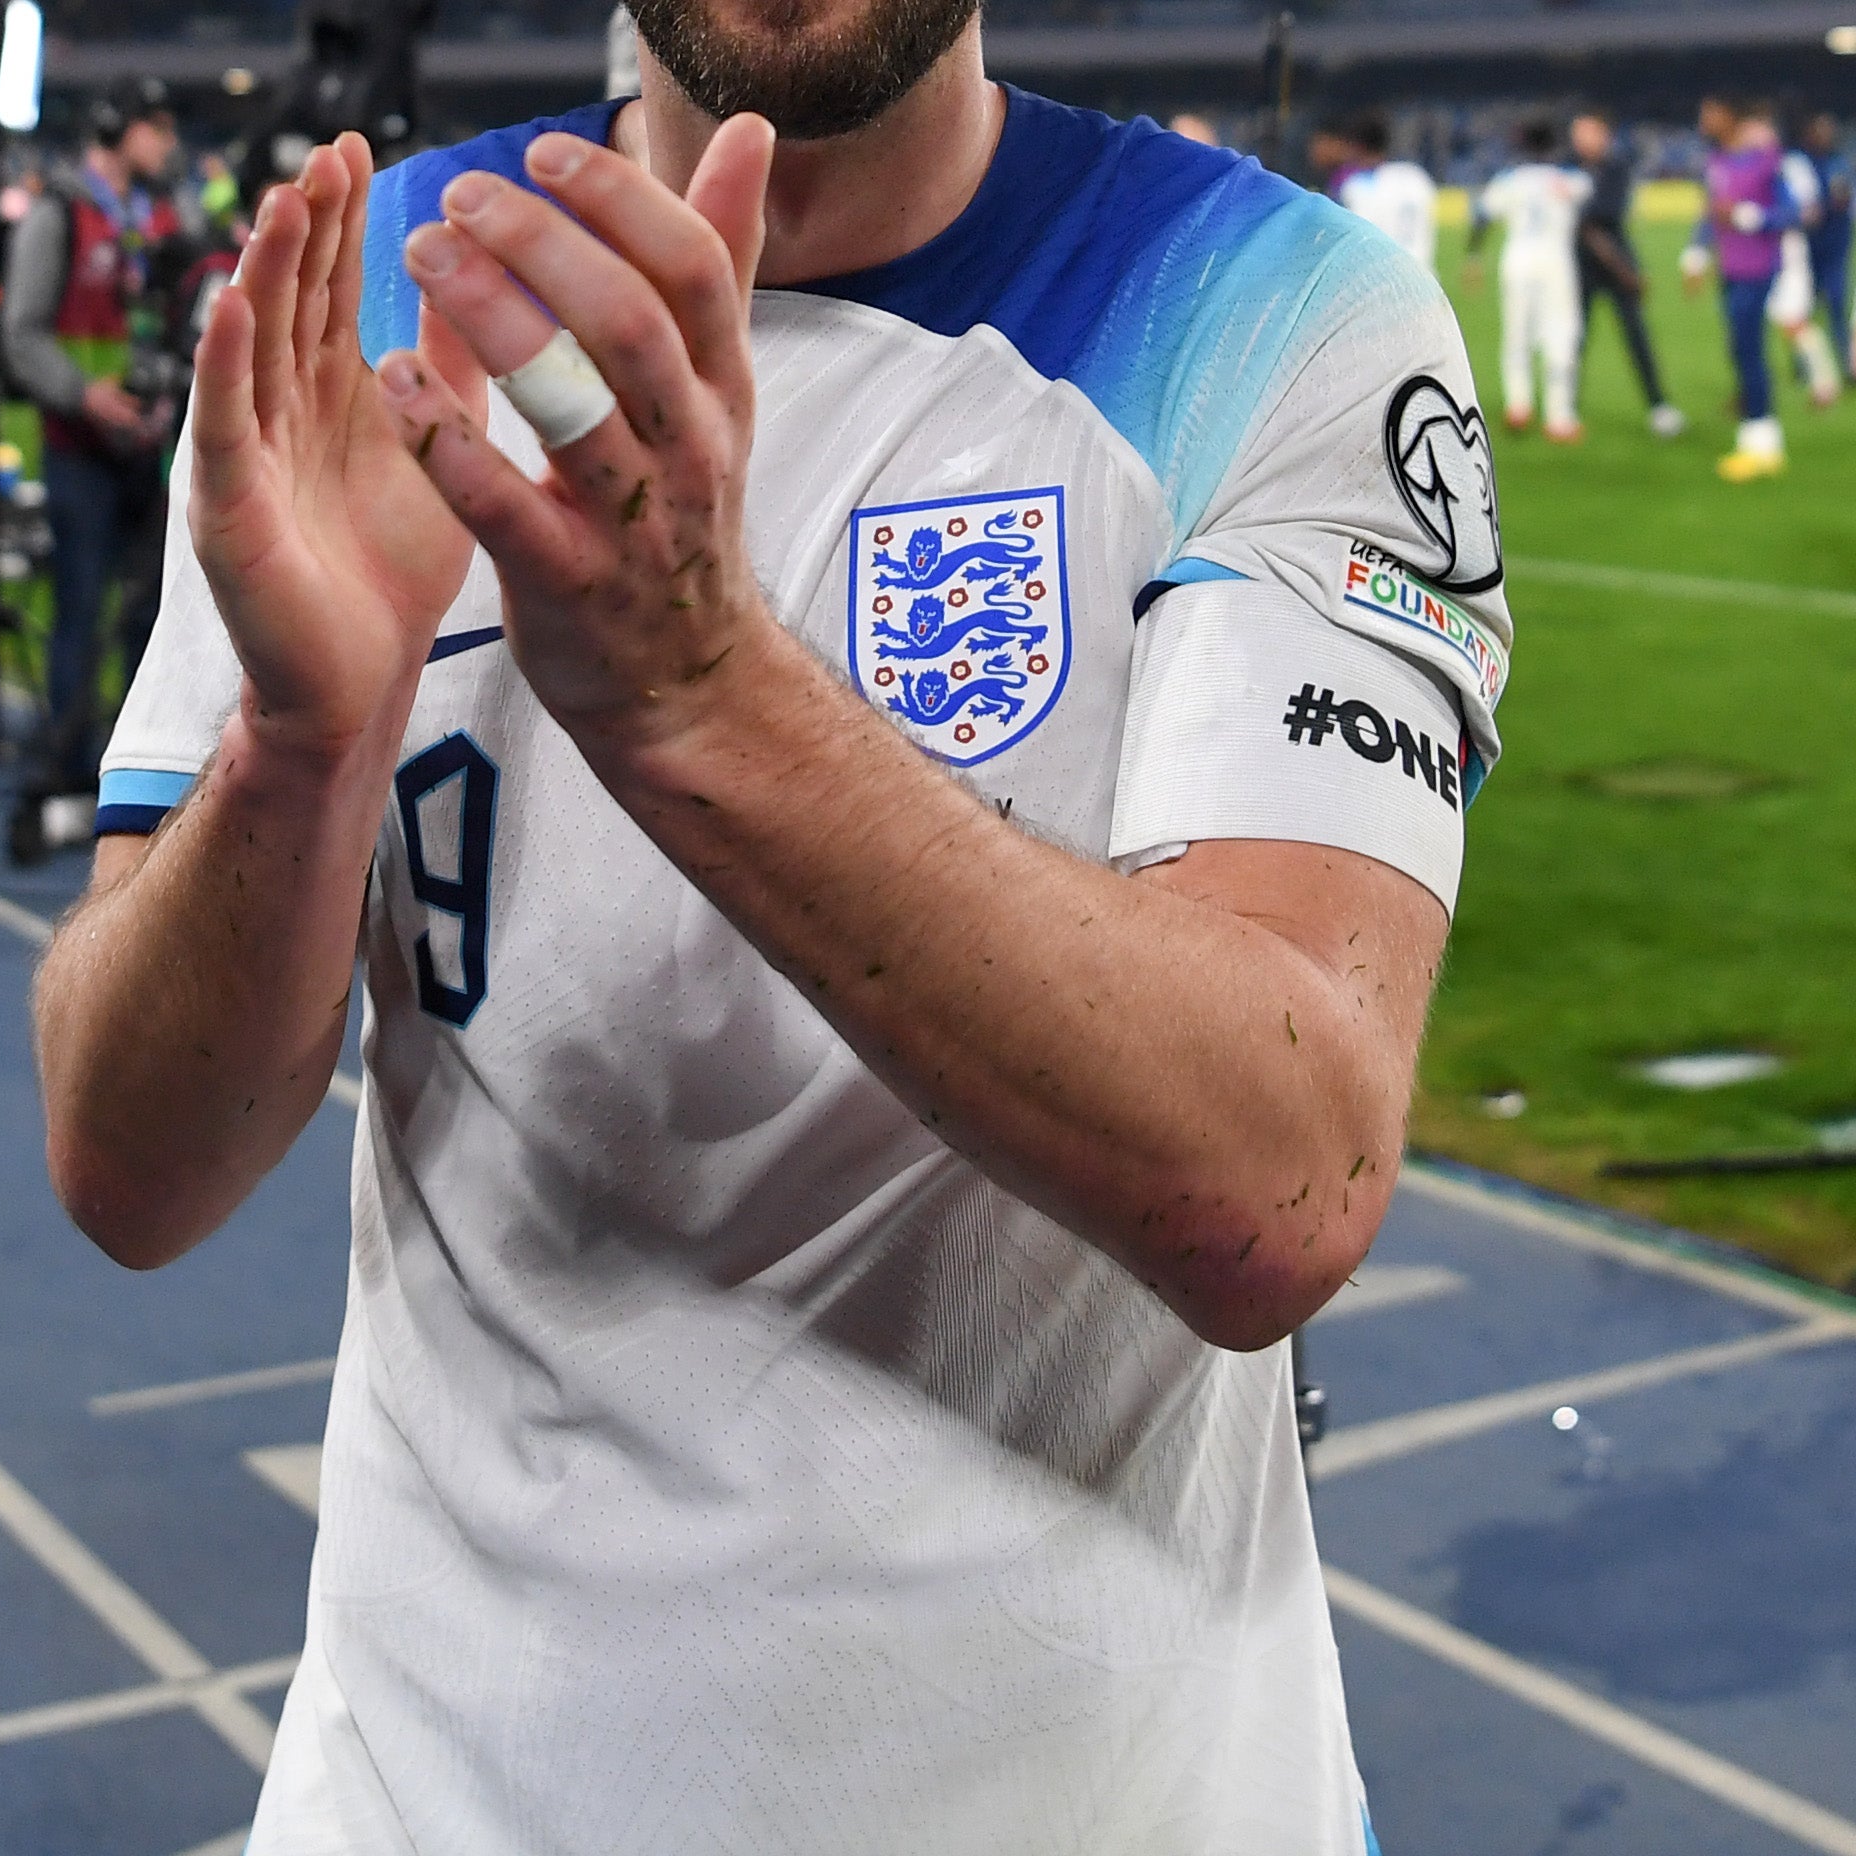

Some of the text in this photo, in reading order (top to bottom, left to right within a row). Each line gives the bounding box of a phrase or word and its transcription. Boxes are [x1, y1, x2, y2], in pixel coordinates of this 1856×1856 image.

[1349, 538, 1406, 576] UEFA
[1346, 560, 1500, 712] FOUNDATIO
[1282, 682, 1459, 813] #ONE
[395, 727, 501, 1030] 9
